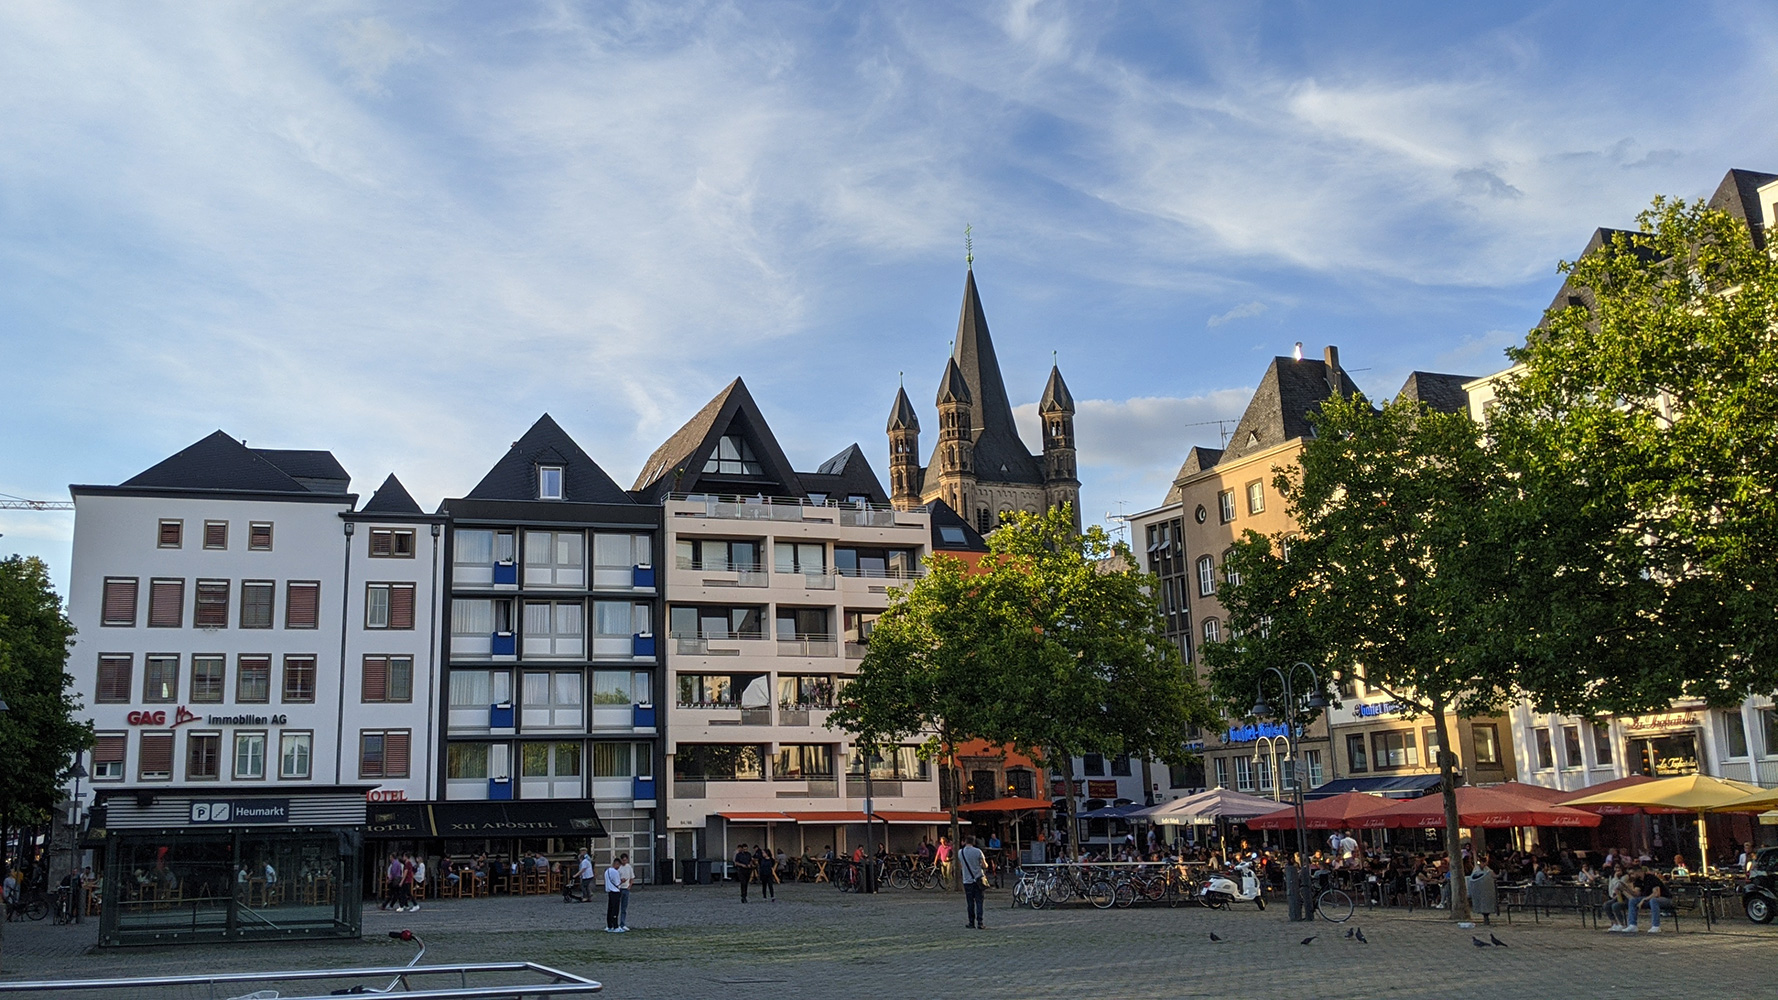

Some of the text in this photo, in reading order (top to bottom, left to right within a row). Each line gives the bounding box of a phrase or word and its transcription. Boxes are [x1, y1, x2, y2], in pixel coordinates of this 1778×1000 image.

[127, 711, 287, 725] GAG Immobilien AG
[236, 806, 285, 816] Heumarkt
[482, 822, 558, 830] APOSTEL
